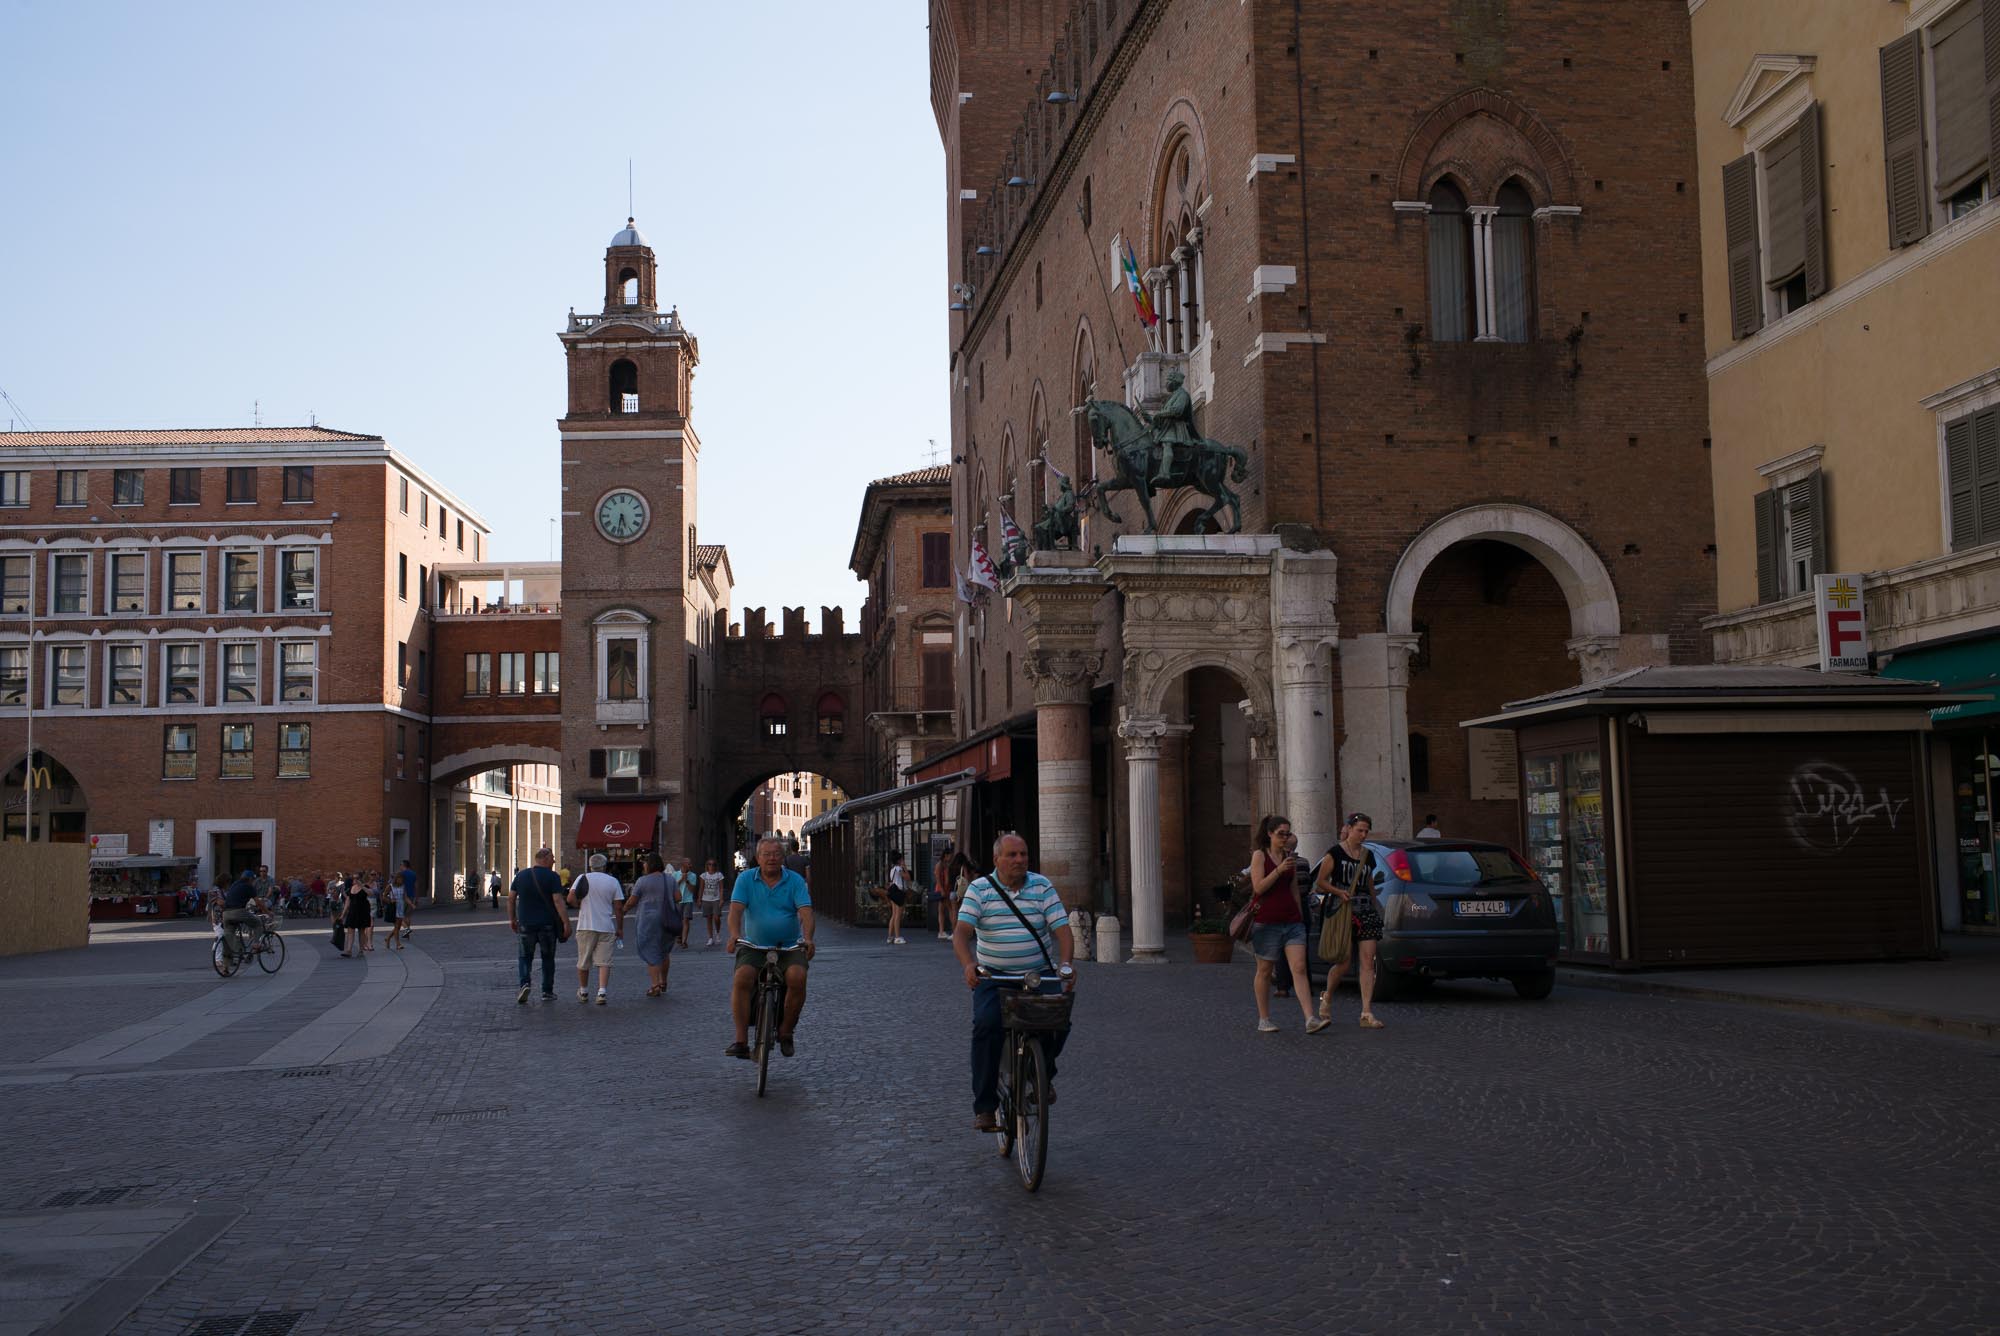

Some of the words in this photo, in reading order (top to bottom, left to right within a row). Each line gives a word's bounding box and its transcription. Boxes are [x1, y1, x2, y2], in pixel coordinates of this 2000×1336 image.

[1828, 611, 1861, 656] F
[1829, 657, 1867, 668] FARMACIA
[1460, 902, 1472, 912] CF
[1475, 902, 1504, 912] 414LP
